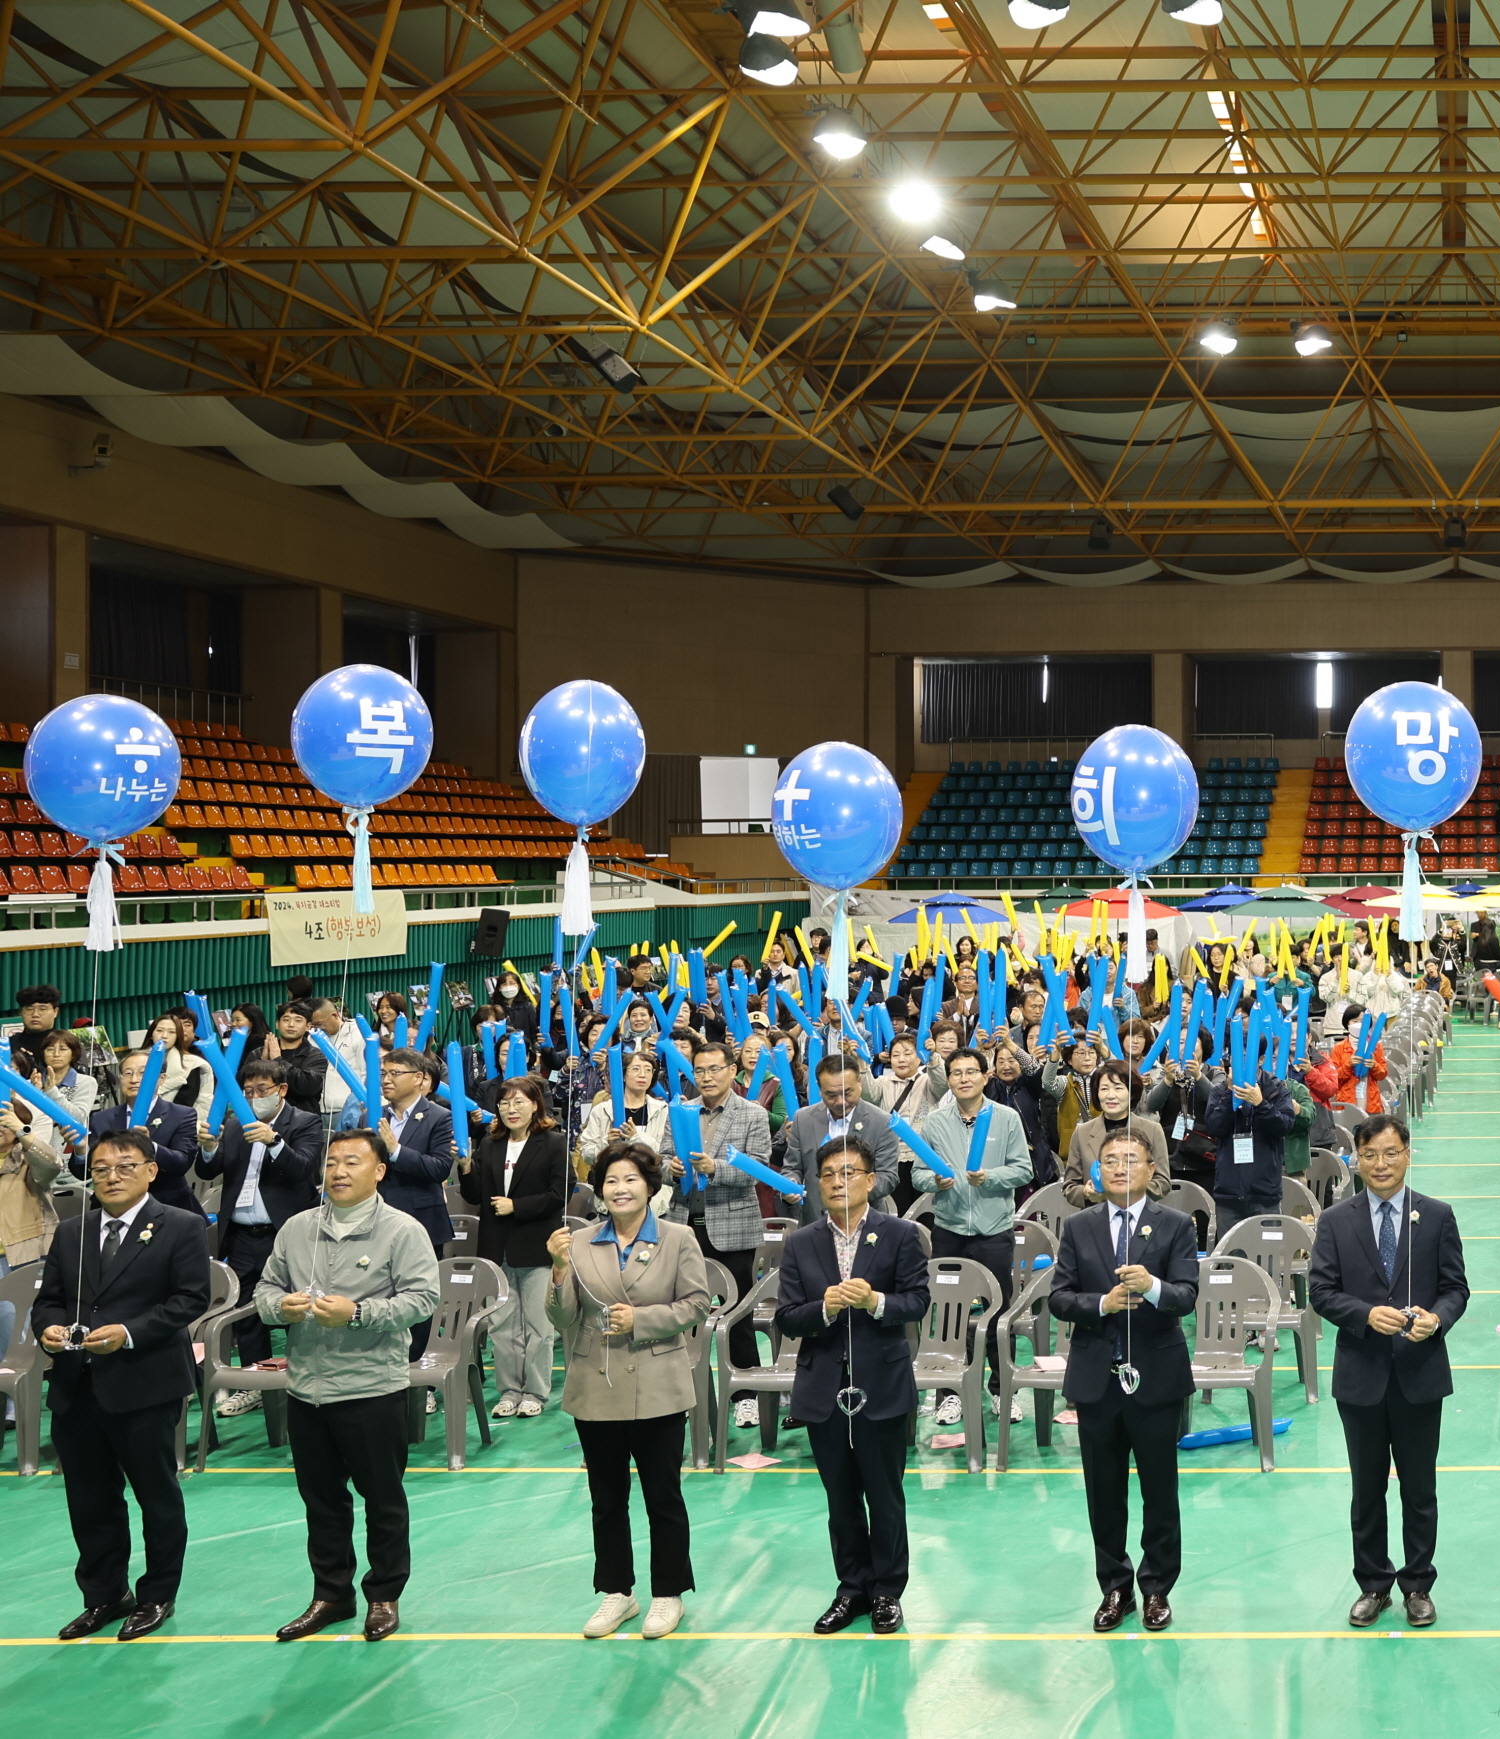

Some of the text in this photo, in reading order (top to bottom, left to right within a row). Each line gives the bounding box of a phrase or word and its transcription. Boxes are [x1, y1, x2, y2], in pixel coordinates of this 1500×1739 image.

[346, 699, 414, 774] 복
[1393, 708, 1460, 785] 망
[99, 777, 168, 802] 나누는
[1073, 765, 1120, 845] 희
[273, 901, 294, 910] 2024.
